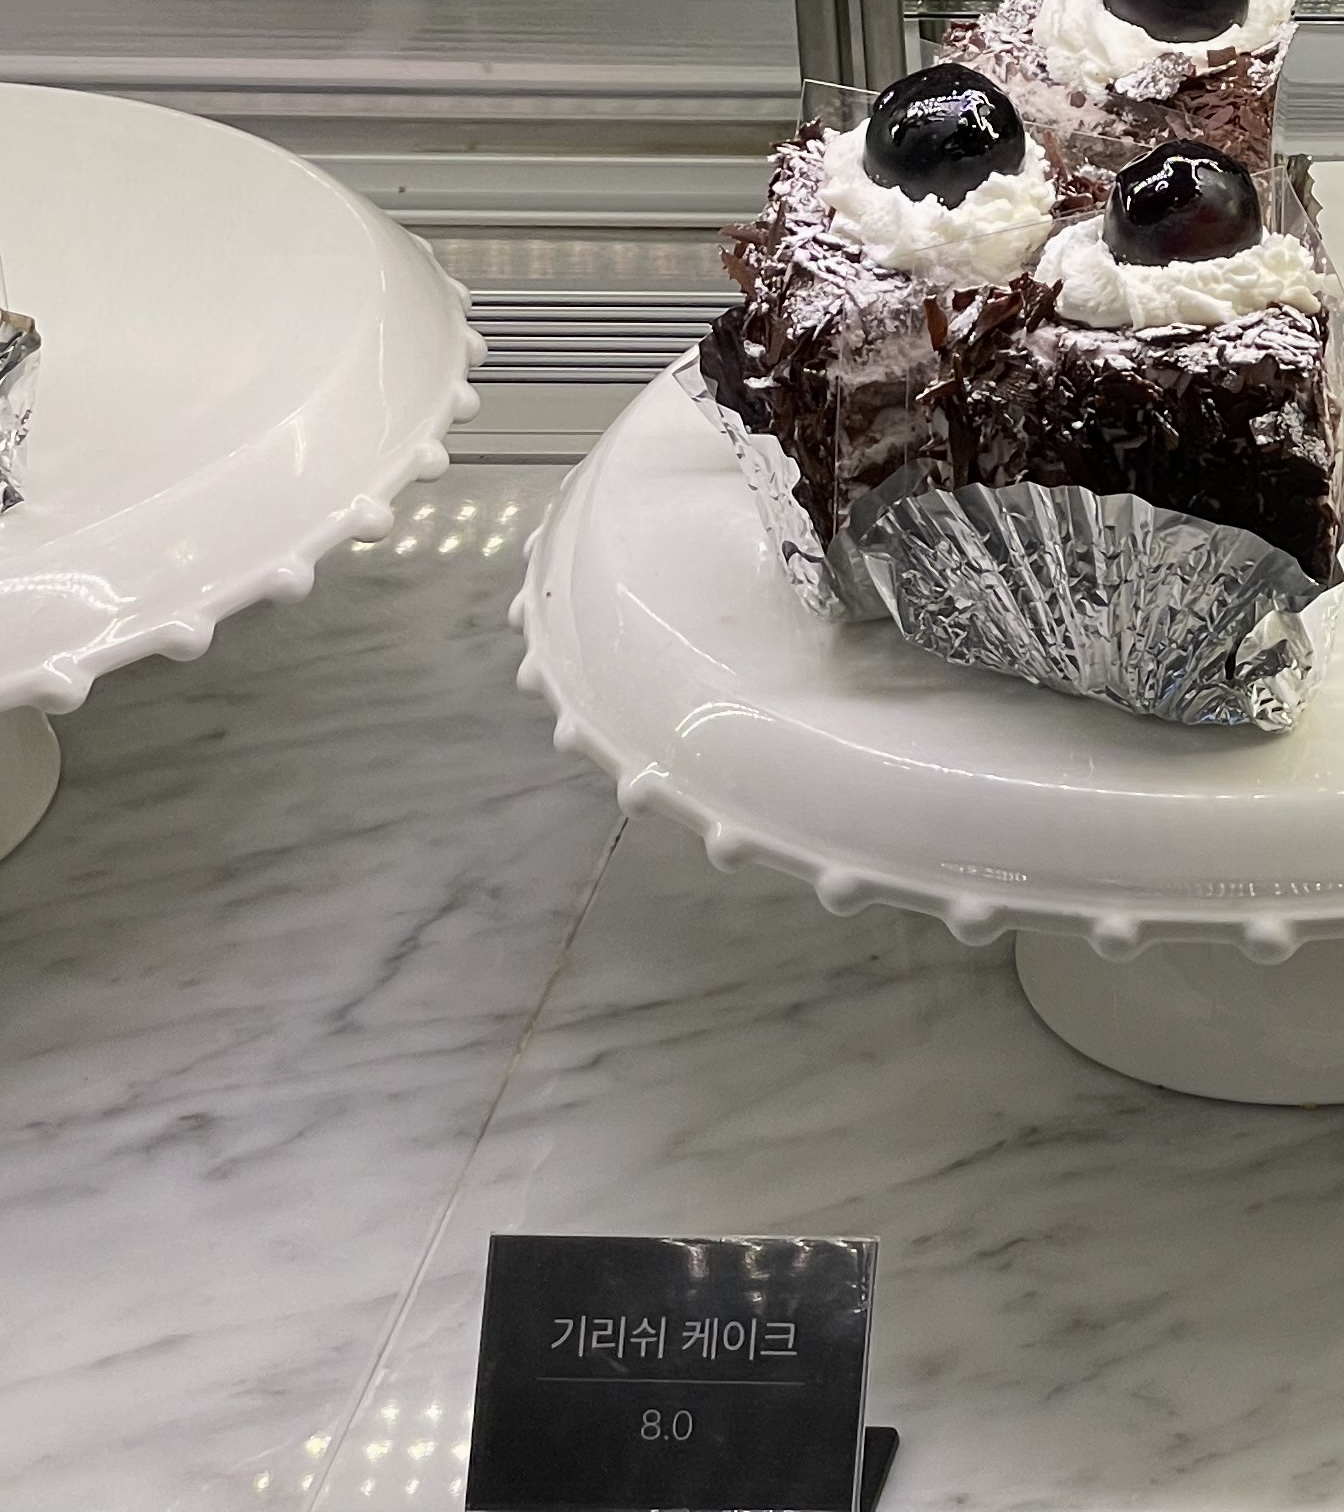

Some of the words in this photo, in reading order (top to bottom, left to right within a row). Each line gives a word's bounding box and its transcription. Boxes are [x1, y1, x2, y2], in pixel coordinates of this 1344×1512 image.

[550, 1314, 668, 1359] 기리쉬
[680, 1317, 798, 1360] 케이크
[639, 1409, 694, 1441] 8.0
